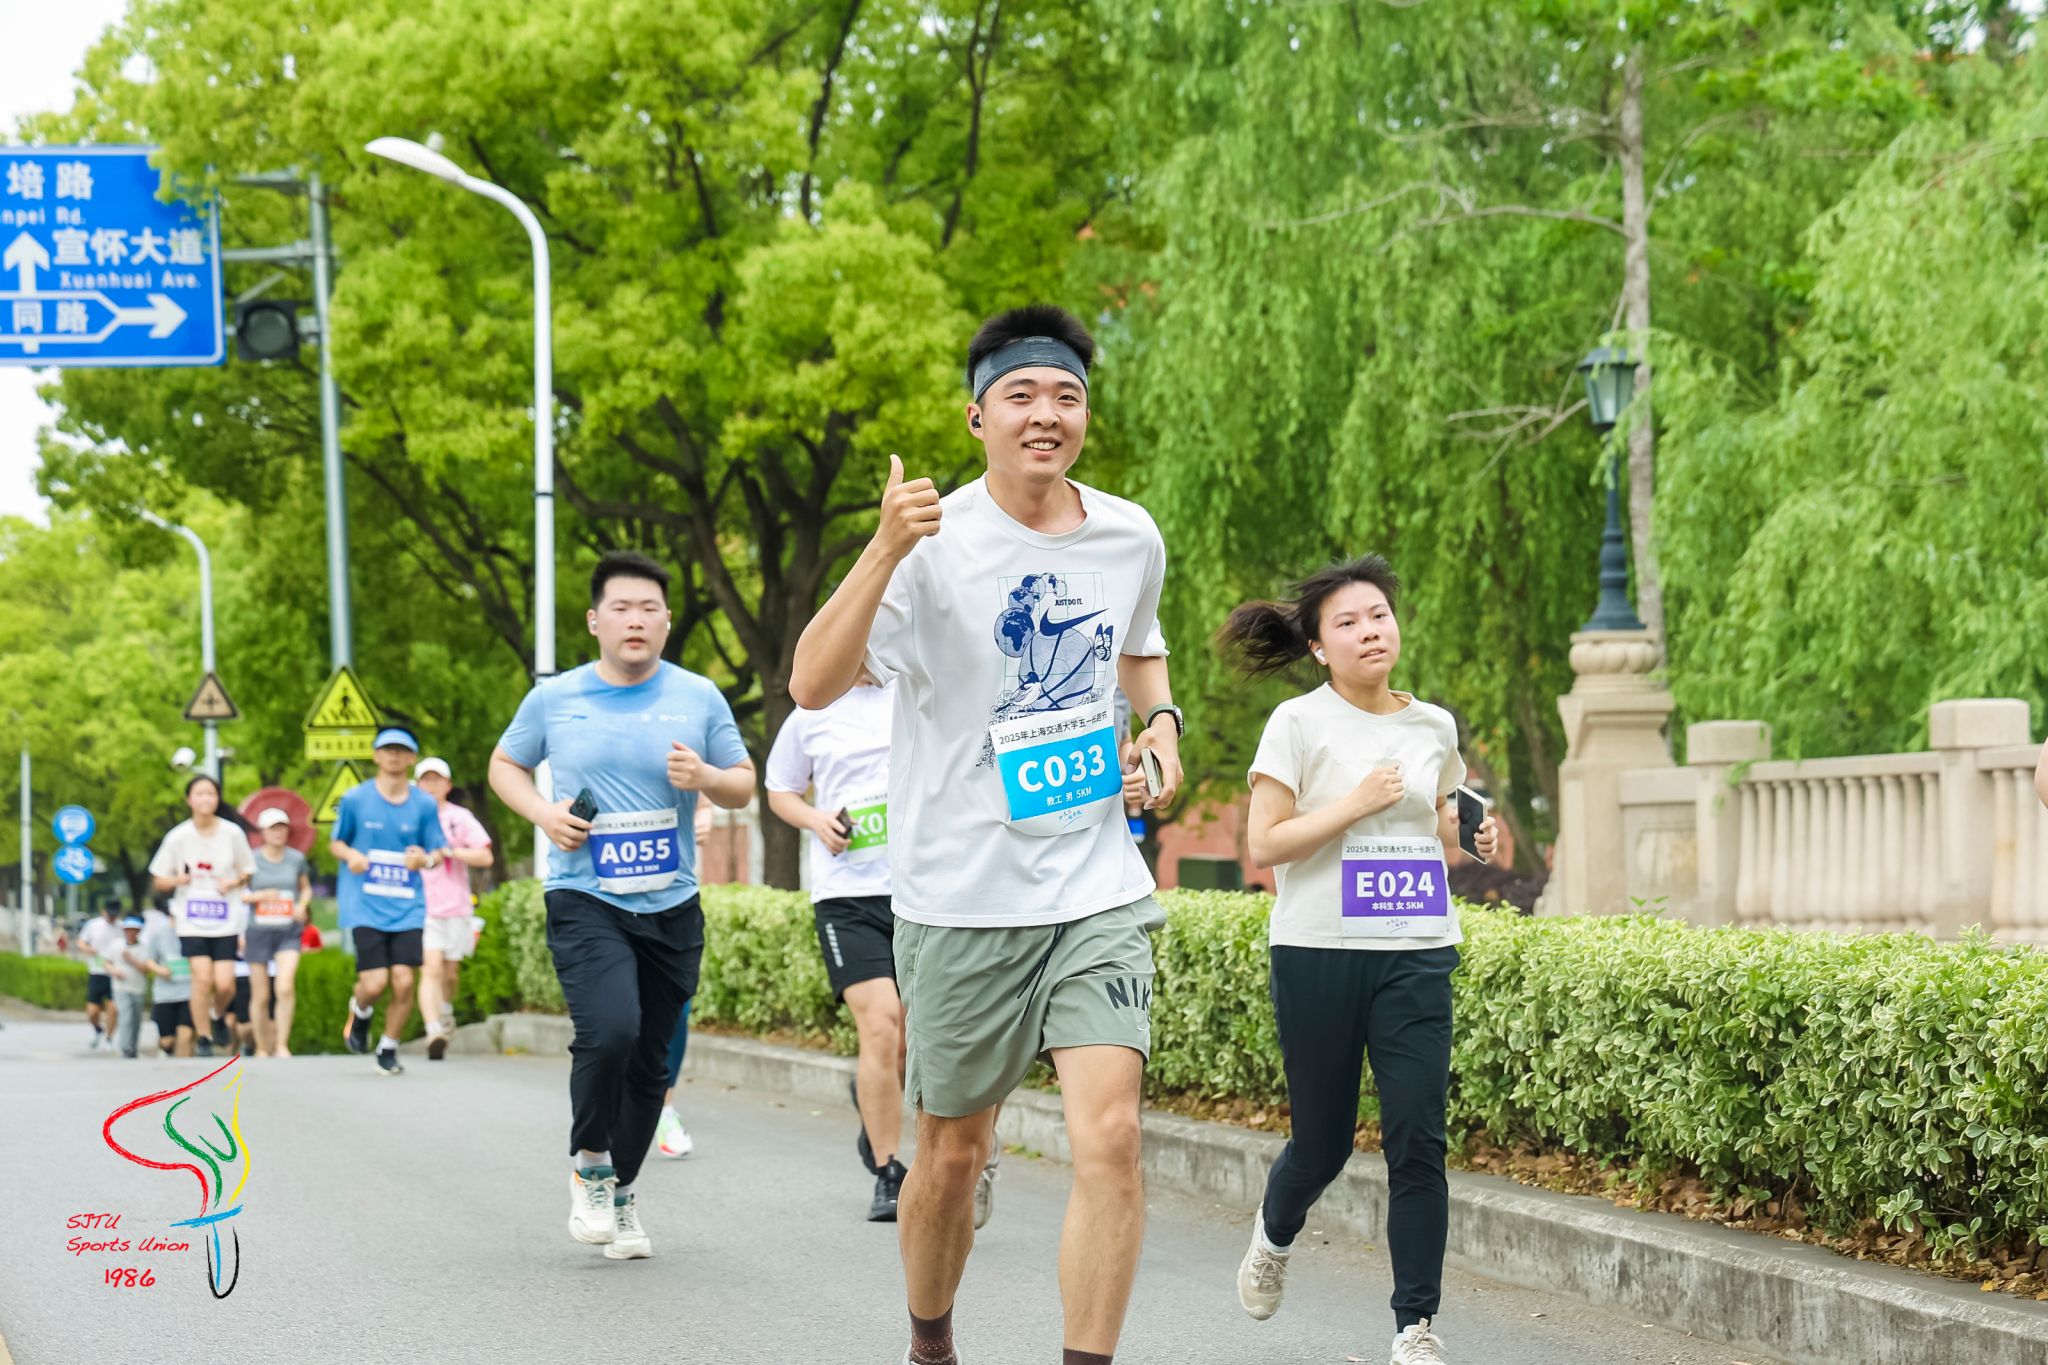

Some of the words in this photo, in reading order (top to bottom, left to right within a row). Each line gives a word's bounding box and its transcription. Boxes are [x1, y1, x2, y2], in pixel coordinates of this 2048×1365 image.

[0, 207, 45, 228] npei
[56, 205, 86, 225] Rd.
[52, 226, 206, 266] 宣怀大道
[59, 270, 152, 289] Xuanhuai
[161, 270, 201, 288] Ave.
[0, 300, 89, 334] 同路
[1017, 744, 1106, 793] C033
[1076, 786, 1092, 799] 5KM
[852, 812, 888, 838] K0
[600, 838, 671, 864] A055
[1356, 871, 1435, 898] E024
[1371, 901, 1395, 911] 本科生
[1395, 901, 1405, 911] 女
[1406, 901, 1424, 910] 5KM
[1104, 976, 1151, 1012] NIK
